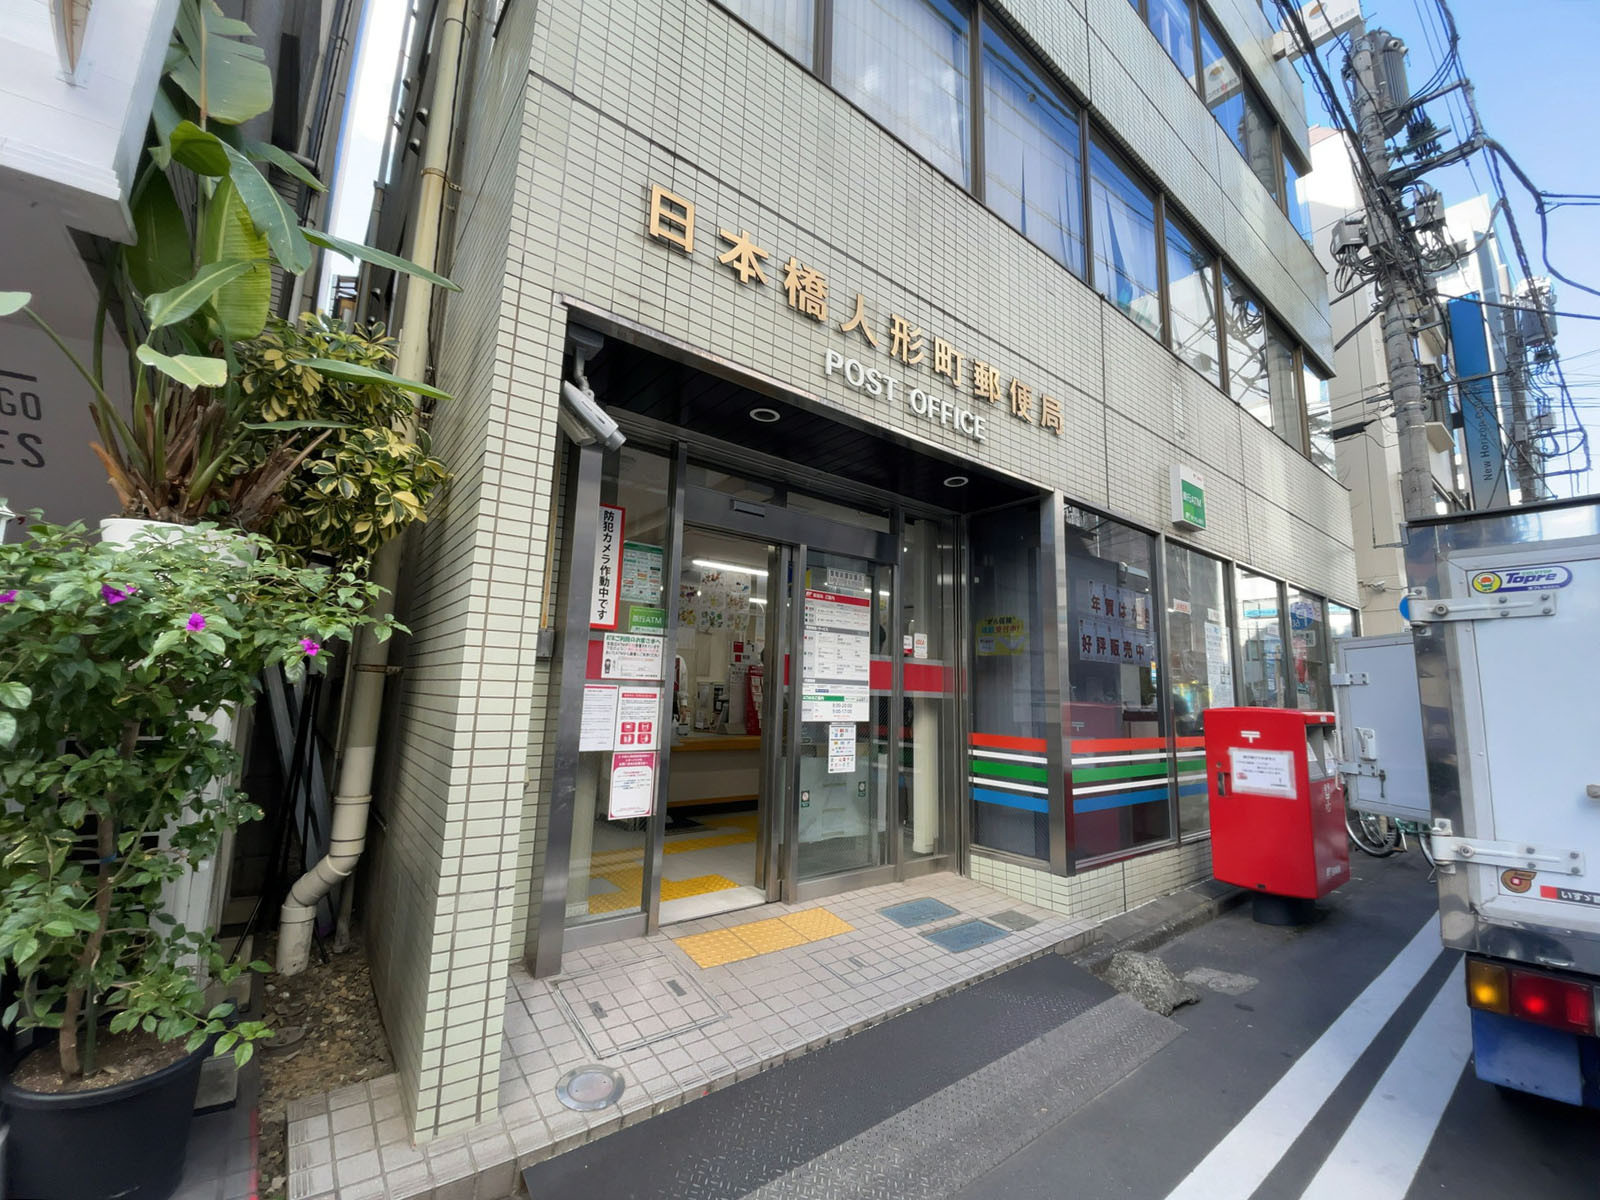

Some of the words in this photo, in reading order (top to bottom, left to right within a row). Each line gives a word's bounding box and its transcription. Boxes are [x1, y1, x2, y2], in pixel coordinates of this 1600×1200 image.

[649, 184, 1064, 435] 日本橋人形町郵便局
[825, 348, 898, 401] POST
[909, 387, 987, 442] OFFICE
[597, 510, 615, 620] 防犯カメラ作動中です
[1505, 573, 1557, 584] Topre
[1081, 633, 1144, 660] 好評販売中
